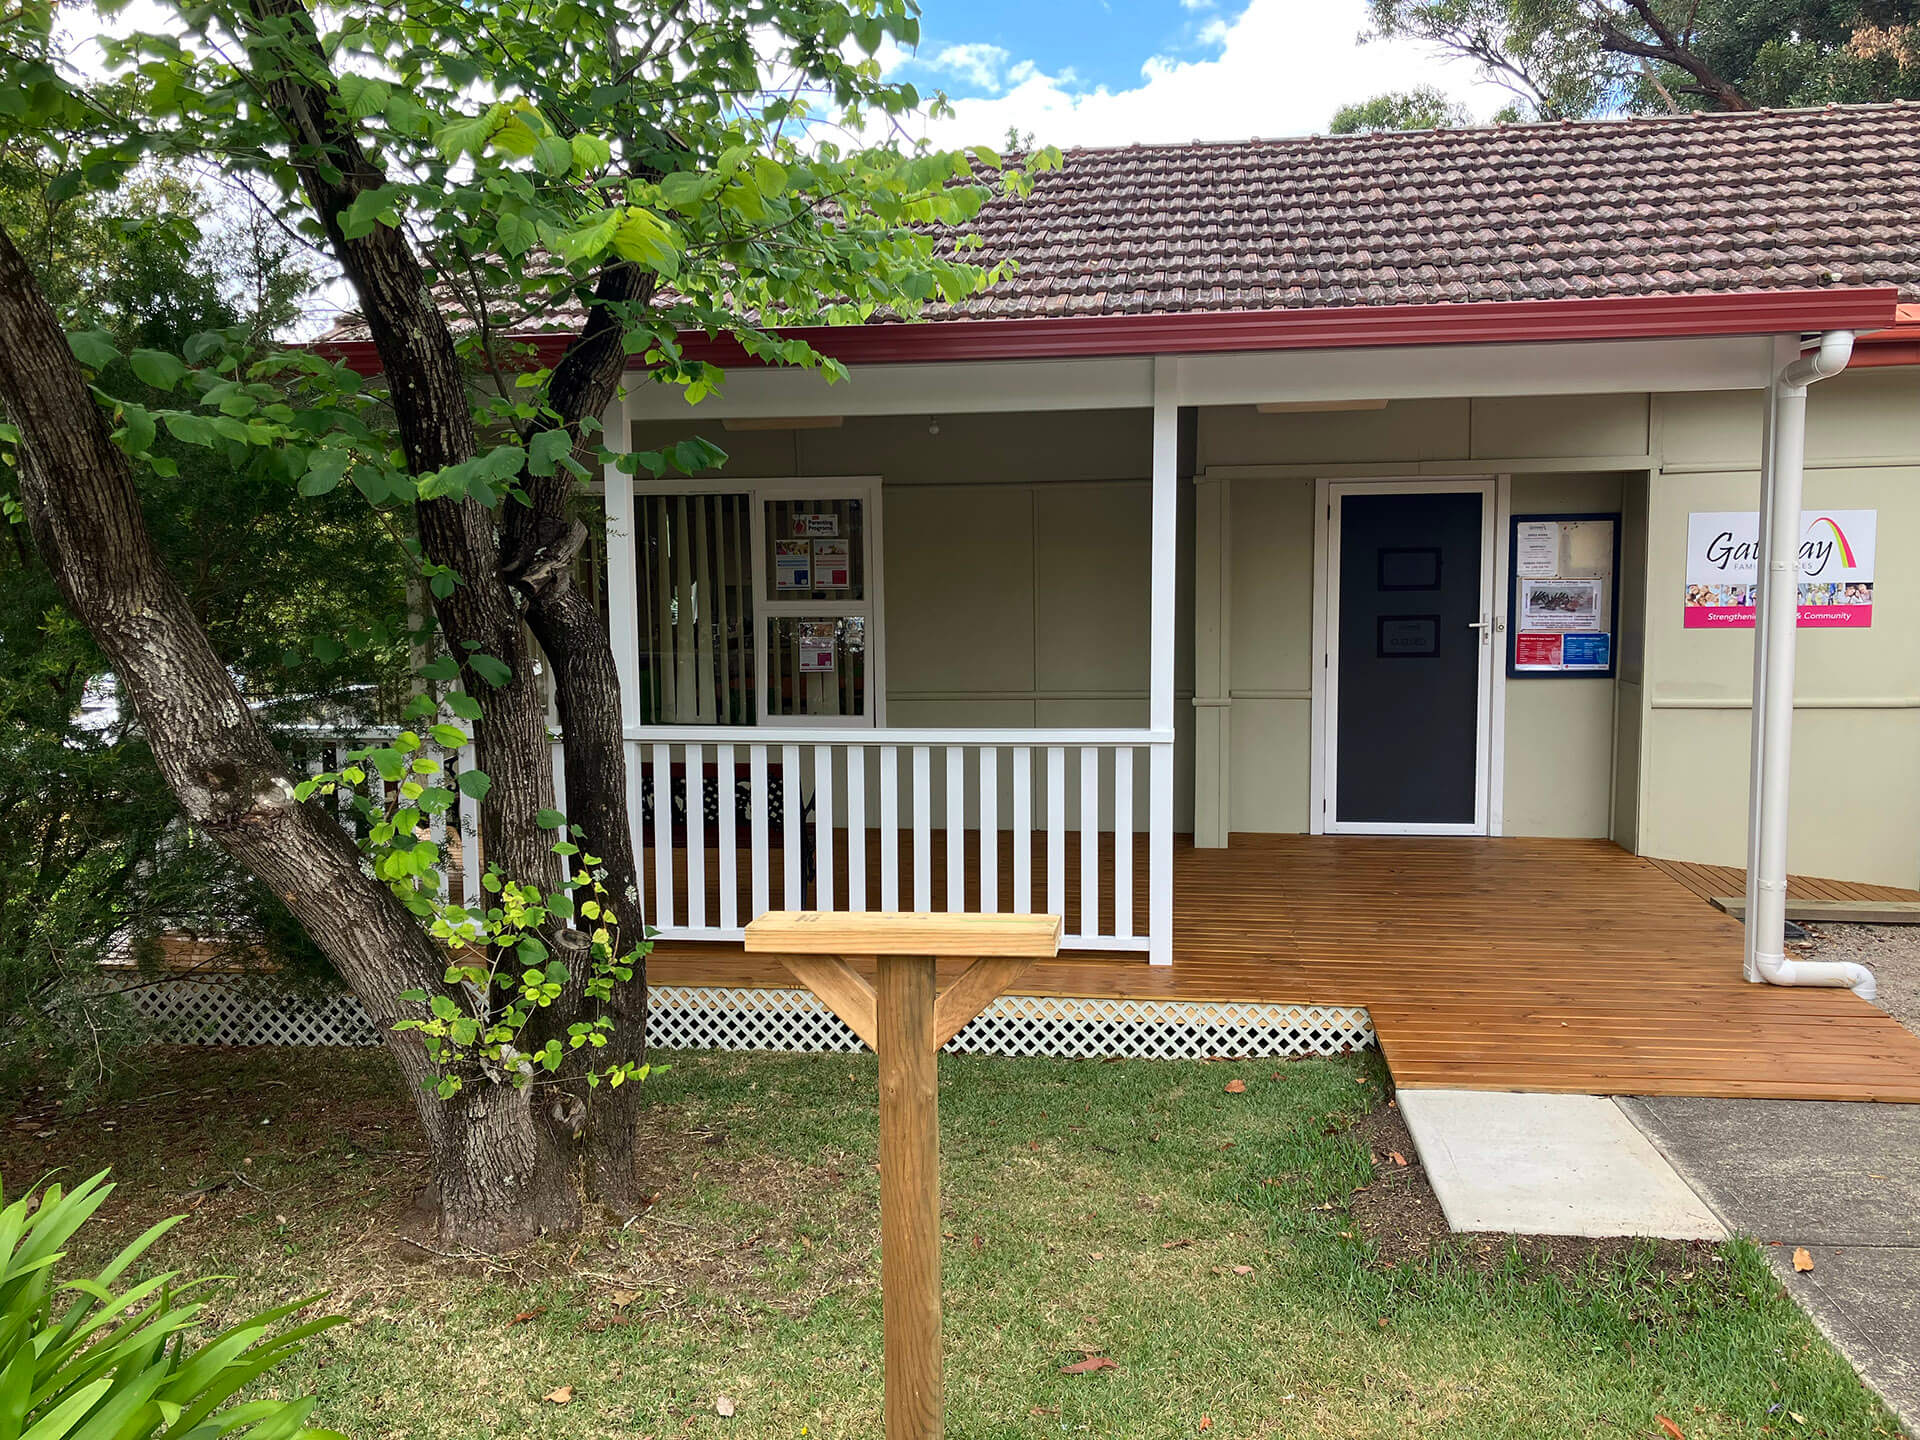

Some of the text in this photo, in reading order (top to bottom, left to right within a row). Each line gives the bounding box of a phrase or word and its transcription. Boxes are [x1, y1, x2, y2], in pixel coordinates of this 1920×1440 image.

[1707, 532, 1833, 576] Gatay
[1707, 612, 1756, 622] Strengtheni
[1804, 612, 1851, 621] Community
